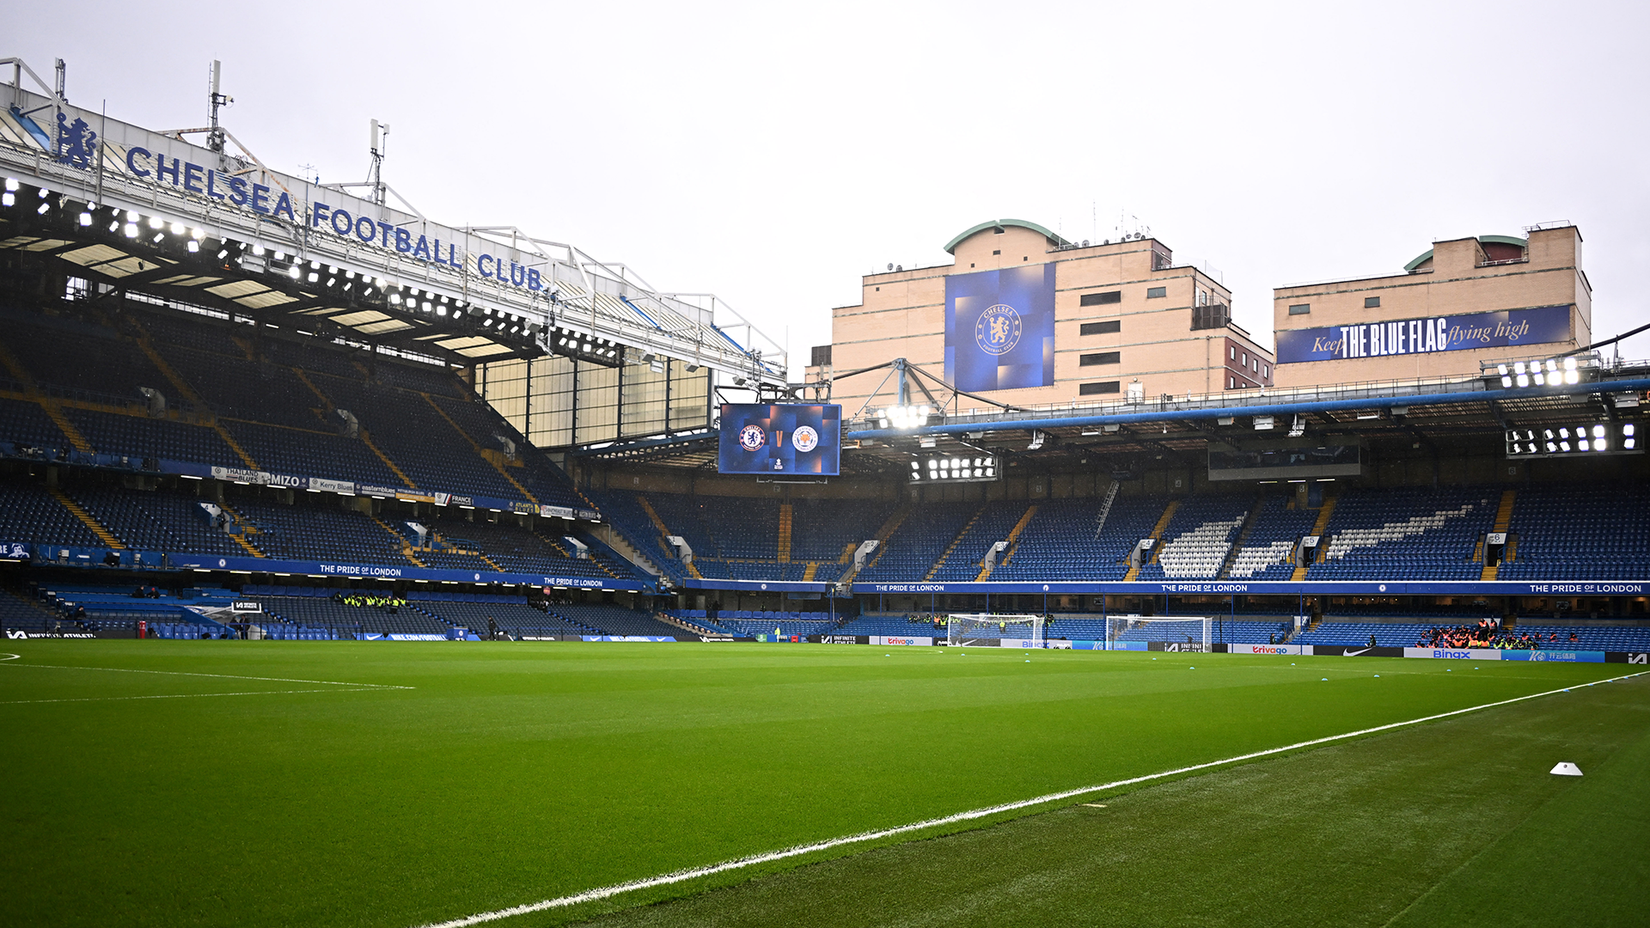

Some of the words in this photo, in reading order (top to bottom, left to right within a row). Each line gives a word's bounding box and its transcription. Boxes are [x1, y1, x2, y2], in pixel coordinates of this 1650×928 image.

[126, 146, 294, 220] CHELSEA
[313, 202, 462, 270] FOOTBALL
[478, 254, 542, 291] CLUB
[984, 306, 1014, 319] CHELSEA
[1312, 336, 1345, 356] Keep
[1340, 326, 1367, 358] THE
[1370, 322, 1406, 356] BLUE
[1409, 318, 1446, 354] FLAG
[1446, 324, 1492, 345] flying
[1494, 320, 1530, 340] high
[271, 474, 300, 486] MIZO
[320, 482, 336, 490] Kerry
[338, 482, 352, 490] Blues
[320, 564, 335, 572] THE
[337, 566, 360, 574] PRIDE
[370, 568, 402, 576] LONDON
[1530, 584, 1548, 592] THE
[1552, 584, 1582, 592] PRIDE
[1584, 584, 1594, 592] OF
[1597, 584, 1642, 592] LONDON
[1252, 646, 1288, 654] trivago
